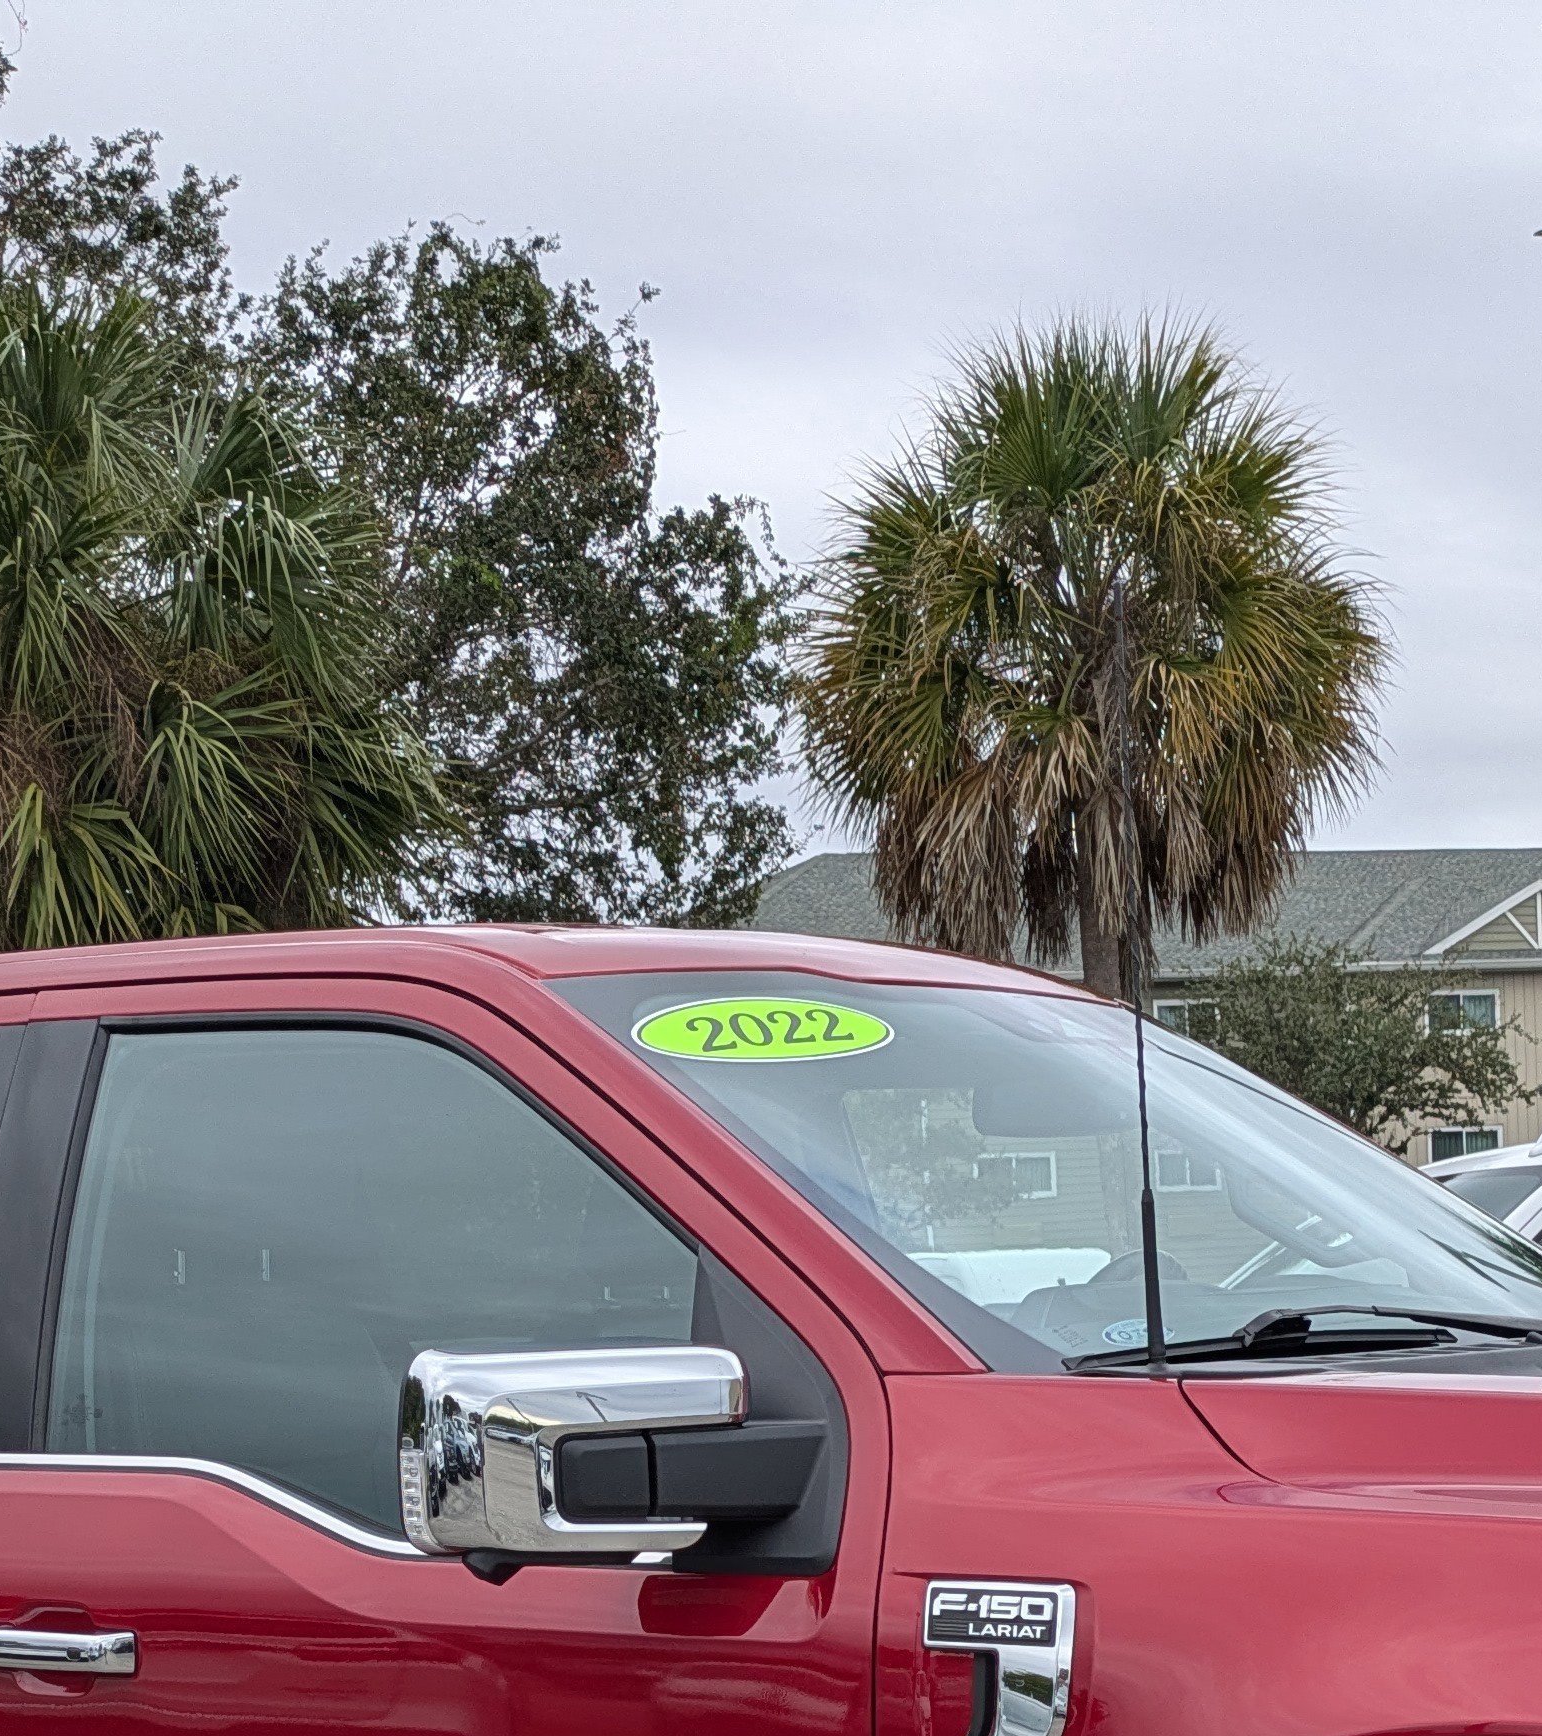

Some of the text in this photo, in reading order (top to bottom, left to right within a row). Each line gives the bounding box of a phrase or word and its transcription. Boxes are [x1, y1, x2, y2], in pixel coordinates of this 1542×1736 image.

[686, 1009, 854, 1052] 2022
[932, 1592, 1054, 1621] F-150
[968, 1622, 1047, 1639] LARIAT
